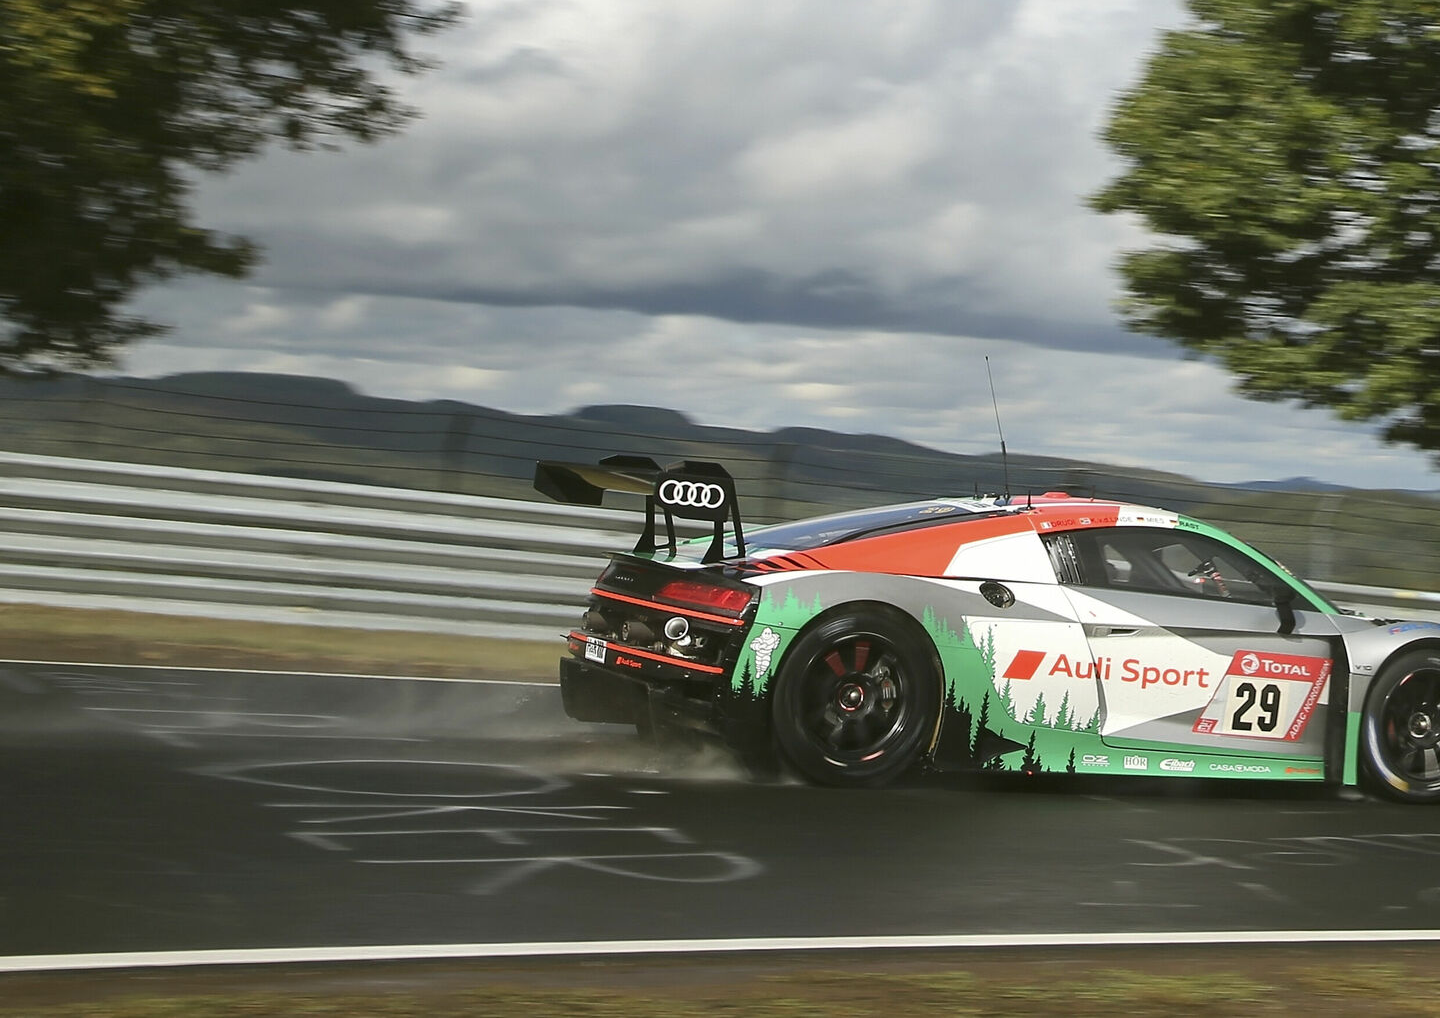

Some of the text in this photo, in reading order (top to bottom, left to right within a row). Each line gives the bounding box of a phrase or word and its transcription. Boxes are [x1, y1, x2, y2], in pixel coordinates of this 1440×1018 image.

[1121, 658, 1210, 689] Sport
[1261, 659, 1311, 676] TOTAL
[1231, 682, 1281, 732] 29
[1288, 713, 1307, 740] ADAC
[1083, 754, 1109, 762] OZ
[1209, 763, 1271, 773] CASA MODA
